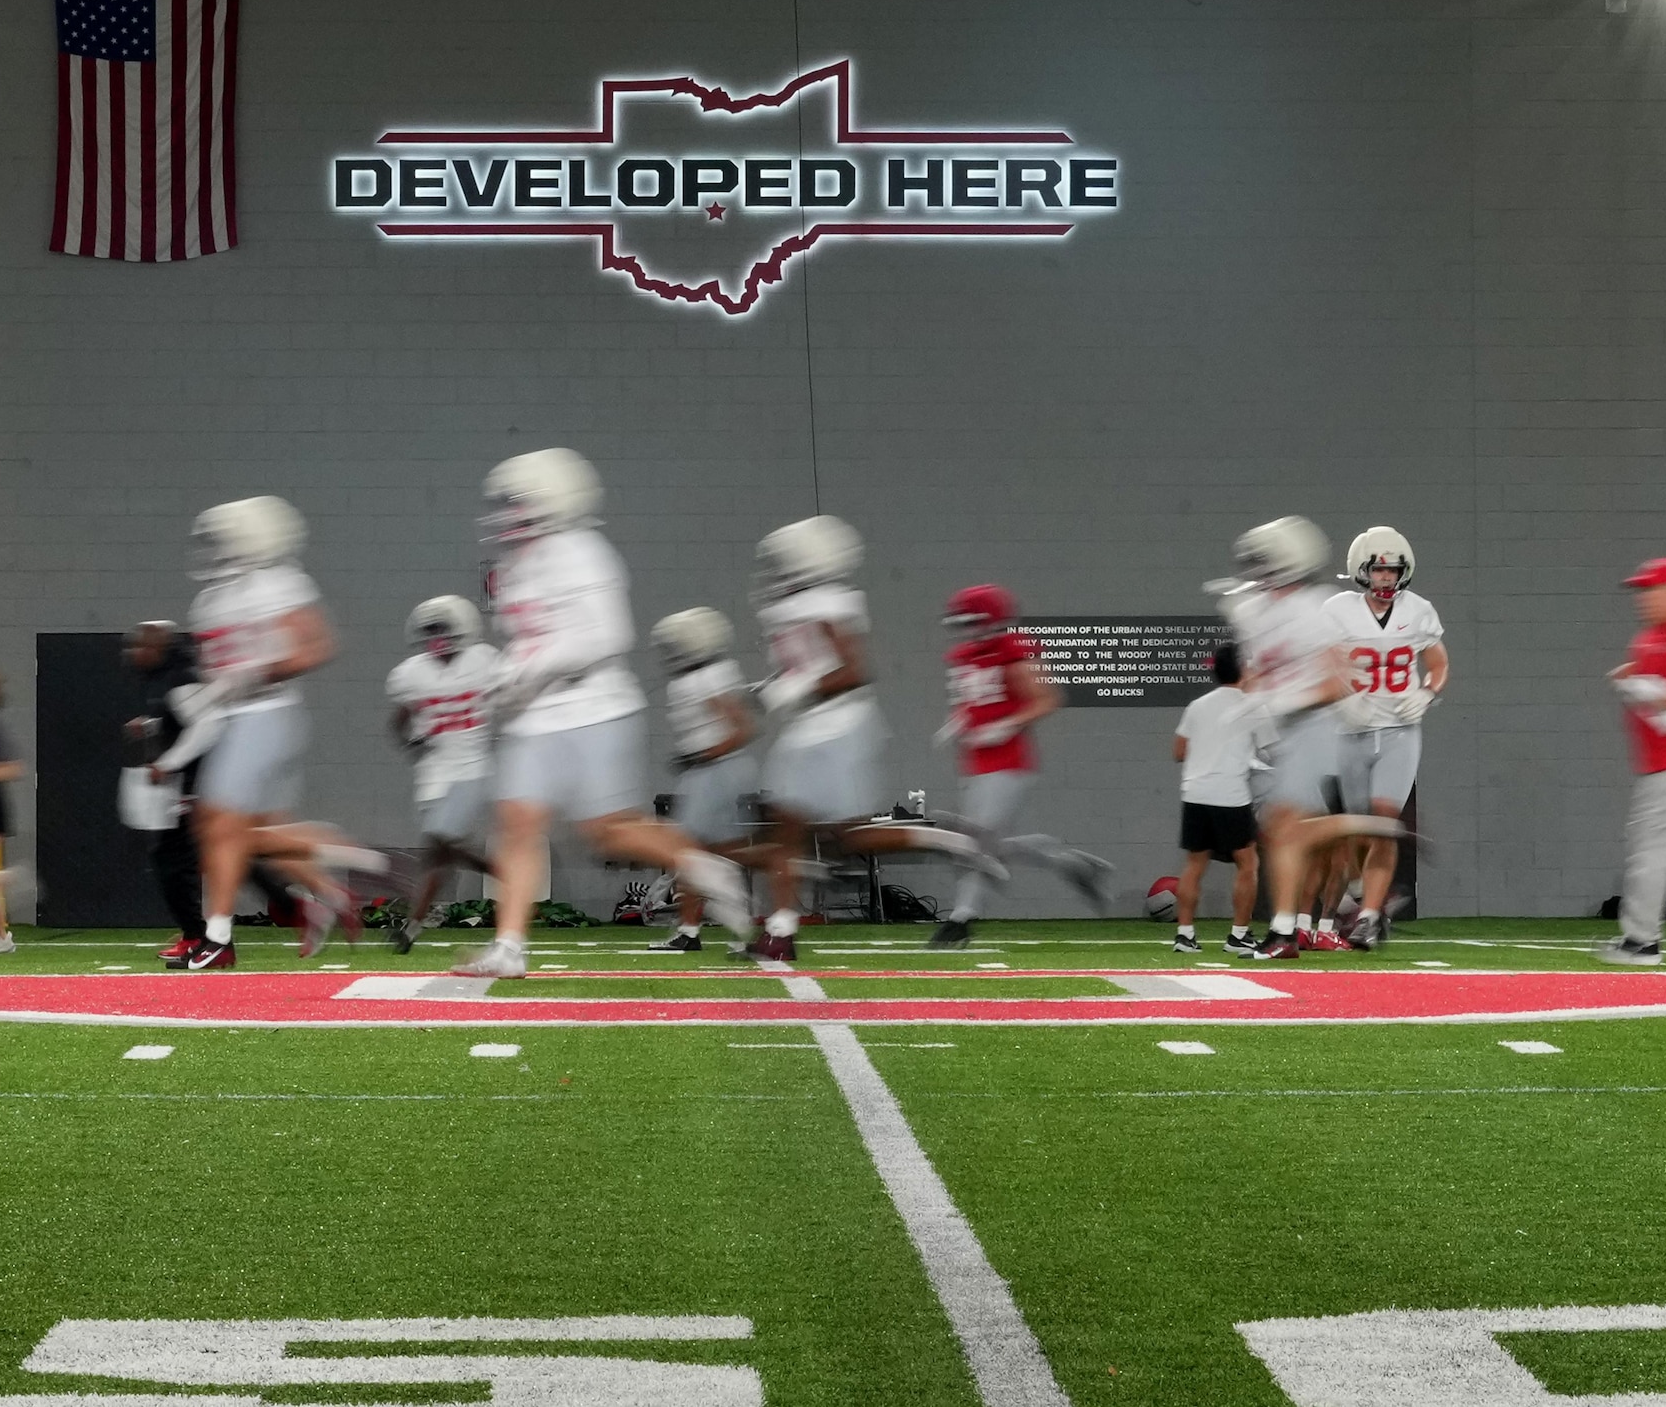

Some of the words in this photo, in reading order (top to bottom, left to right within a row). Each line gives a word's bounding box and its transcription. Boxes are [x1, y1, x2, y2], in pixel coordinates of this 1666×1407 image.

[335, 159, 856, 207] DEVELOPED
[888, 159, 1117, 207] HERE
[1007, 626, 1017, 634] IN
[1018, 626, 1078, 634] RECOGNITION
[1079, 626, 1091, 634] OF
[1093, 626, 1110, 634] THE
[1112, 626, 1142, 634] URBAN
[1144, 626, 1163, 634] AND
[1165, 626, 1201, 634] SHELLEY
[1040, 651, 1072, 659] BOARD
[1077, 651, 1090, 659] TO
[1095, 651, 1112, 659] THE
[1118, 651, 1152, 659] WOODY
[1158, 651, 1186, 659] HAYES
[1349, 646, 1415, 693] 38
[1035, 676, 1071, 684] ATIONAL
[1072, 676, 1139, 684] CHAMPIONSHIP
[1140, 676, 1185, 684] FOOTBALL
[1187, 676, 1213, 684] TEAM.
